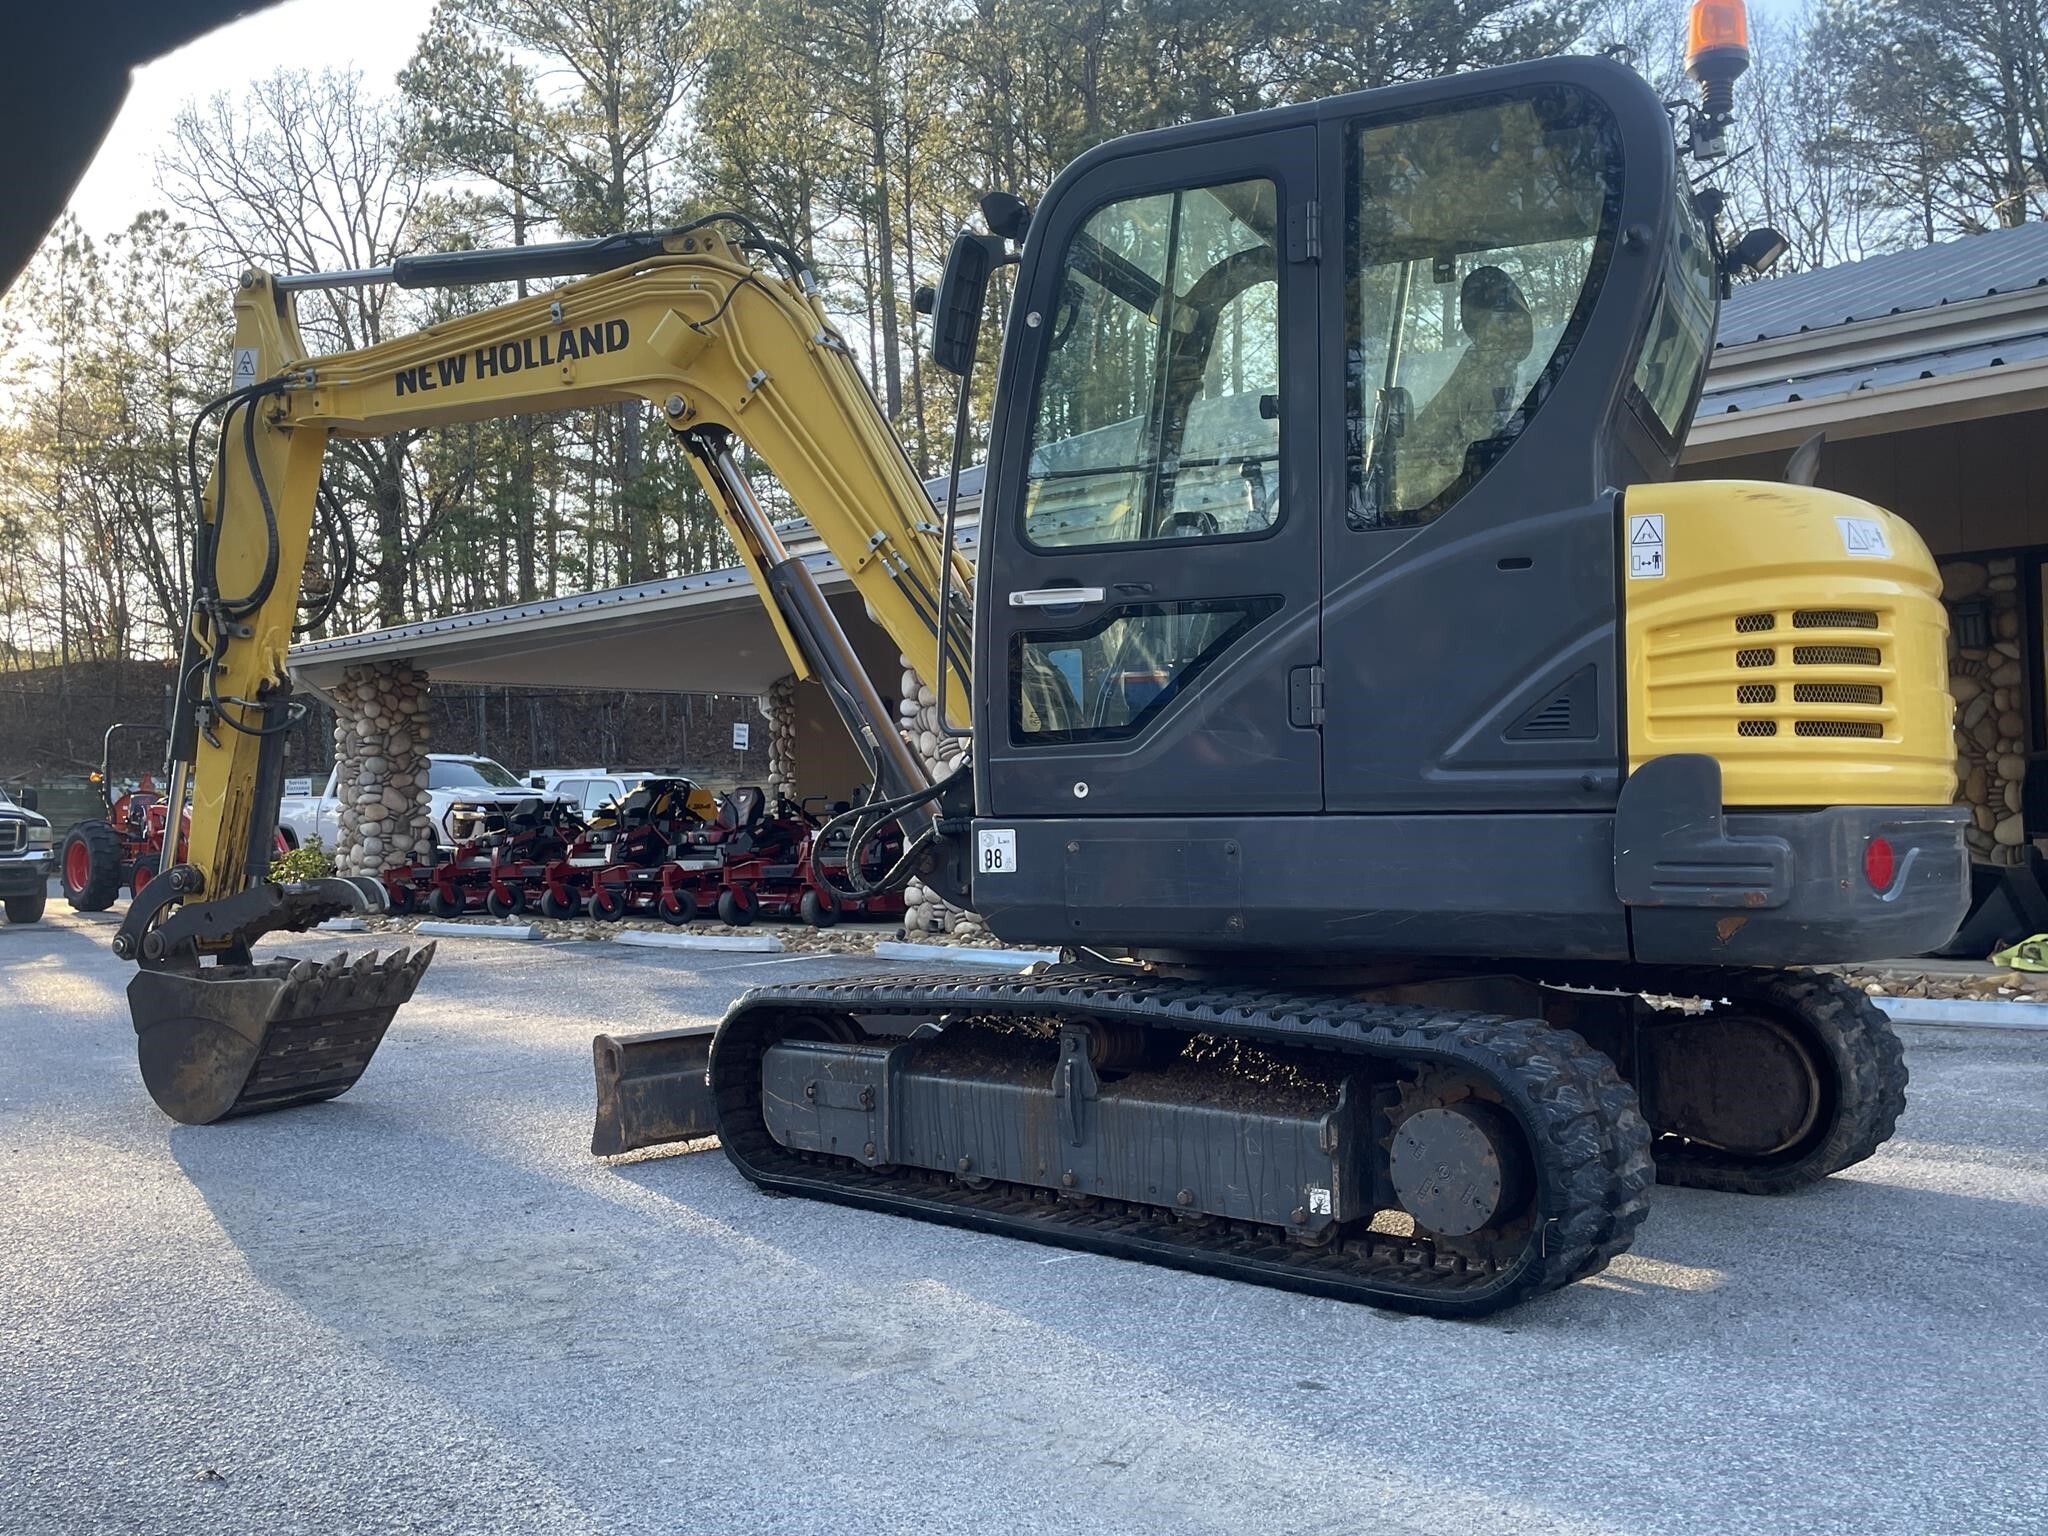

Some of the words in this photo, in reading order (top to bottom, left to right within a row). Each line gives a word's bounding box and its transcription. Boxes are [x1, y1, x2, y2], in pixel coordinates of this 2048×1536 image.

[395, 354, 466, 397] NEW
[475, 318, 630, 380] HOLLAND
[984, 848, 1003, 869] 98
